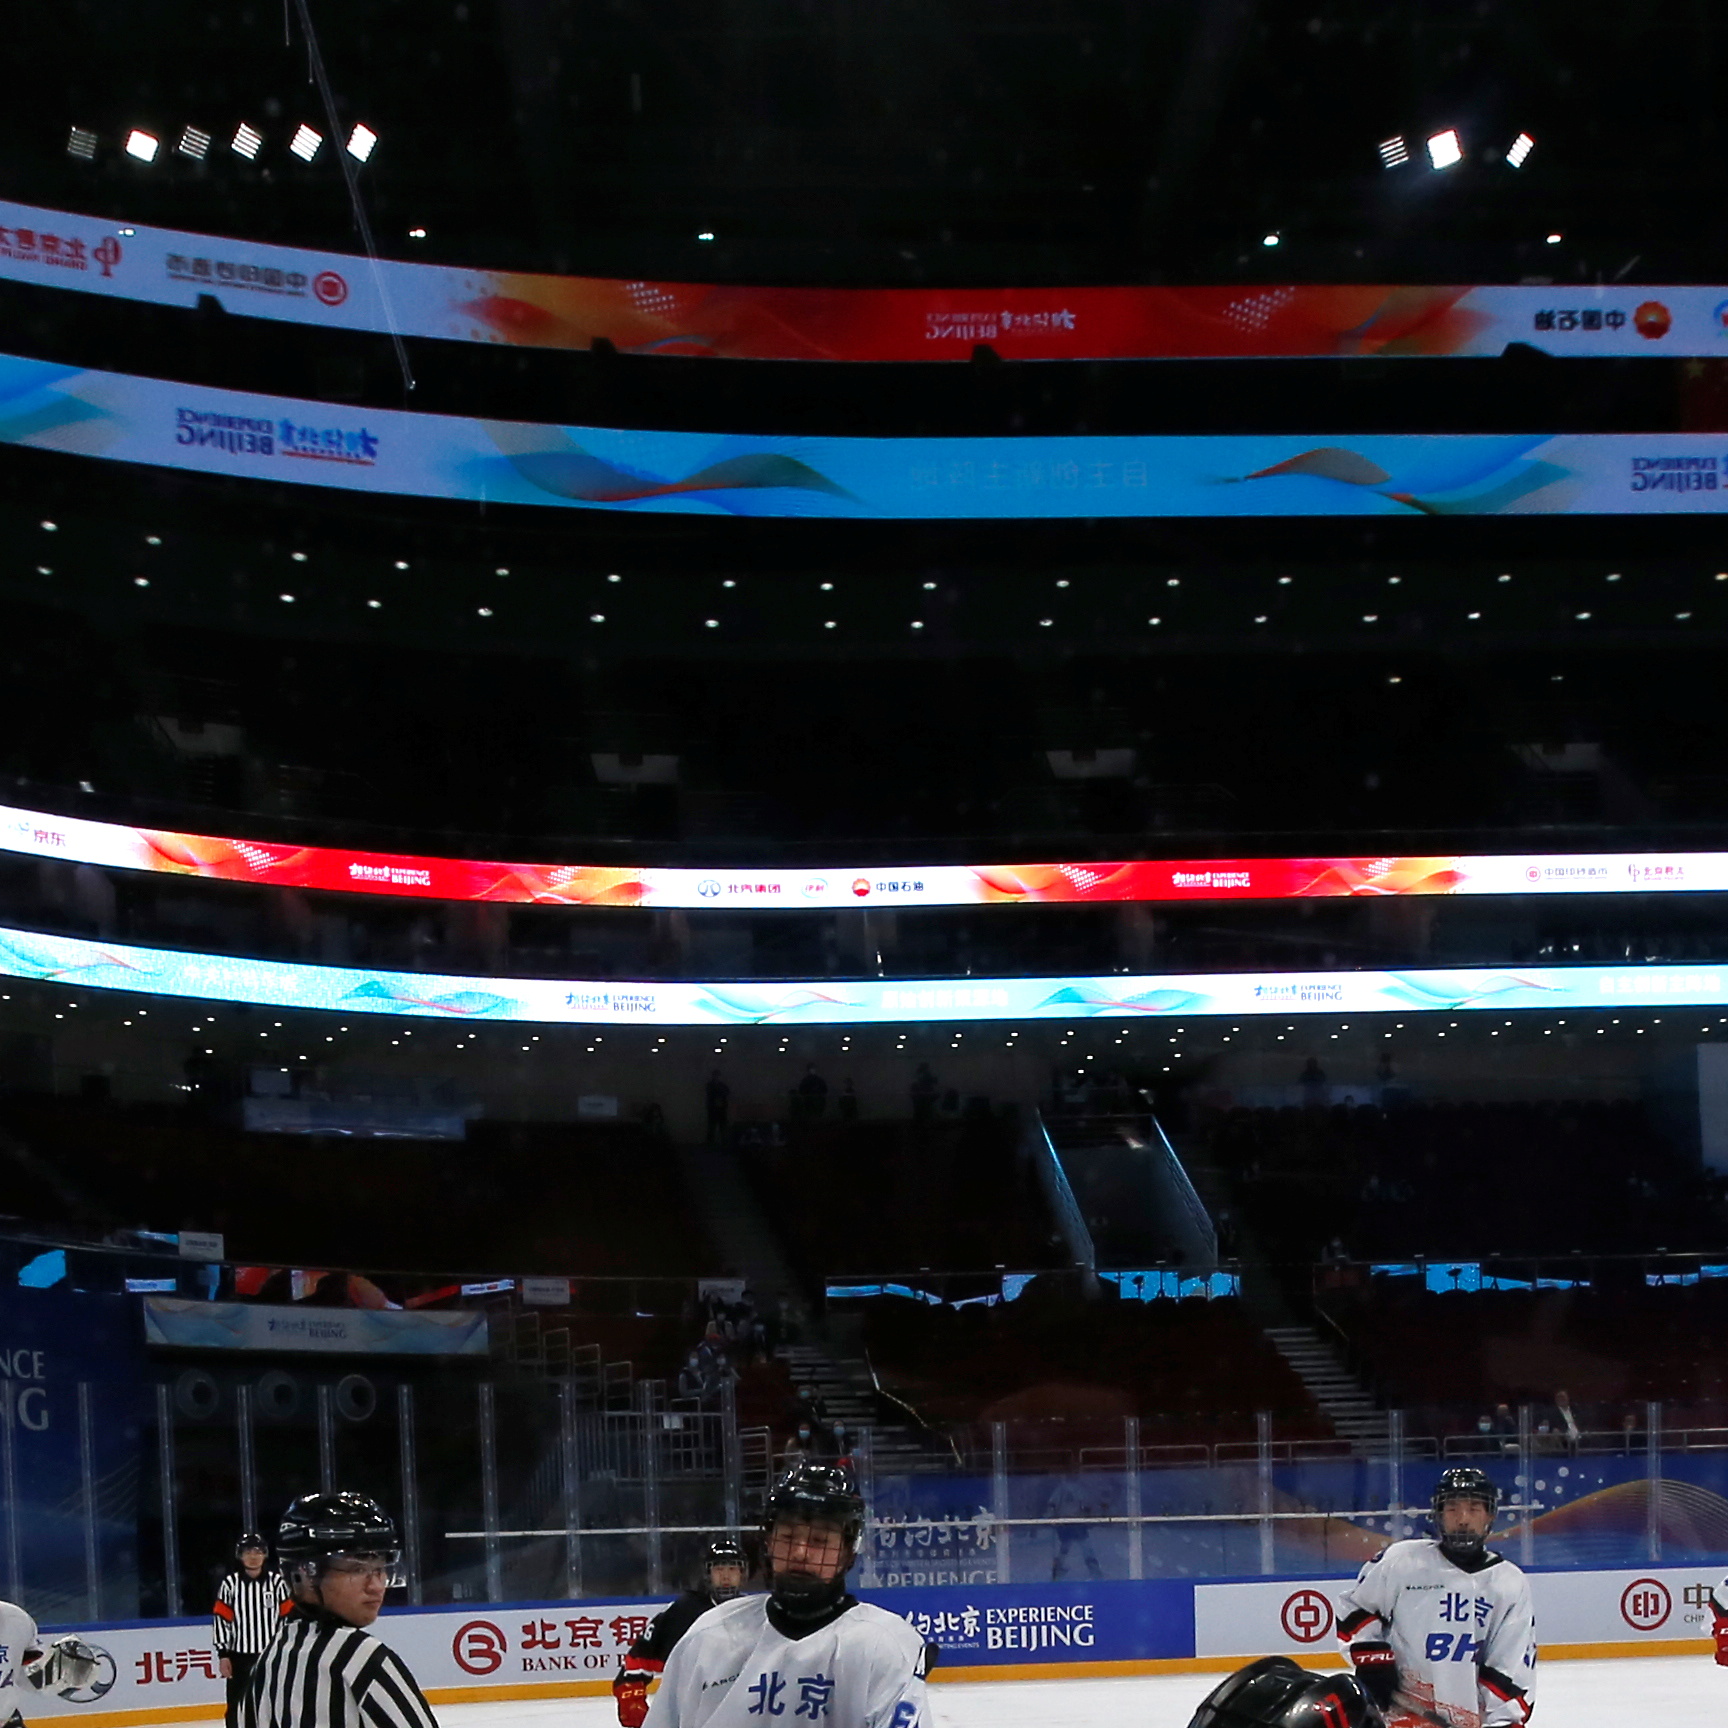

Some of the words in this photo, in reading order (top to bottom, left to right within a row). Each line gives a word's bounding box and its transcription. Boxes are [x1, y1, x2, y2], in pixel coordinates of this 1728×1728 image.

[728, 884, 781, 893] 北汽集团
[876, 881, 924, 892] 中国石油
[1301, 992, 1343, 1001] BEIJING
[613, 1003, 656, 1012] BEIJING
[309, 1329, 349, 1340] BEIJING
[986, 1605, 1094, 1625] EXPERIENCE
[1439, 1592, 1494, 1628] 北京
[904, 1604, 980, 1637] 约北京
[521, 1616, 650, 1650] 北京银
[987, 1622, 1095, 1651] BEIJING
[1426, 1632, 1480, 1662] BH
[136, 1648, 223, 1684] 北汽
[522, 1654, 578, 1672] BANK
[584, 1654, 610, 1669] OF
[1357, 1652, 1395, 1664] TRU
[748, 1671, 835, 1721] 北京
